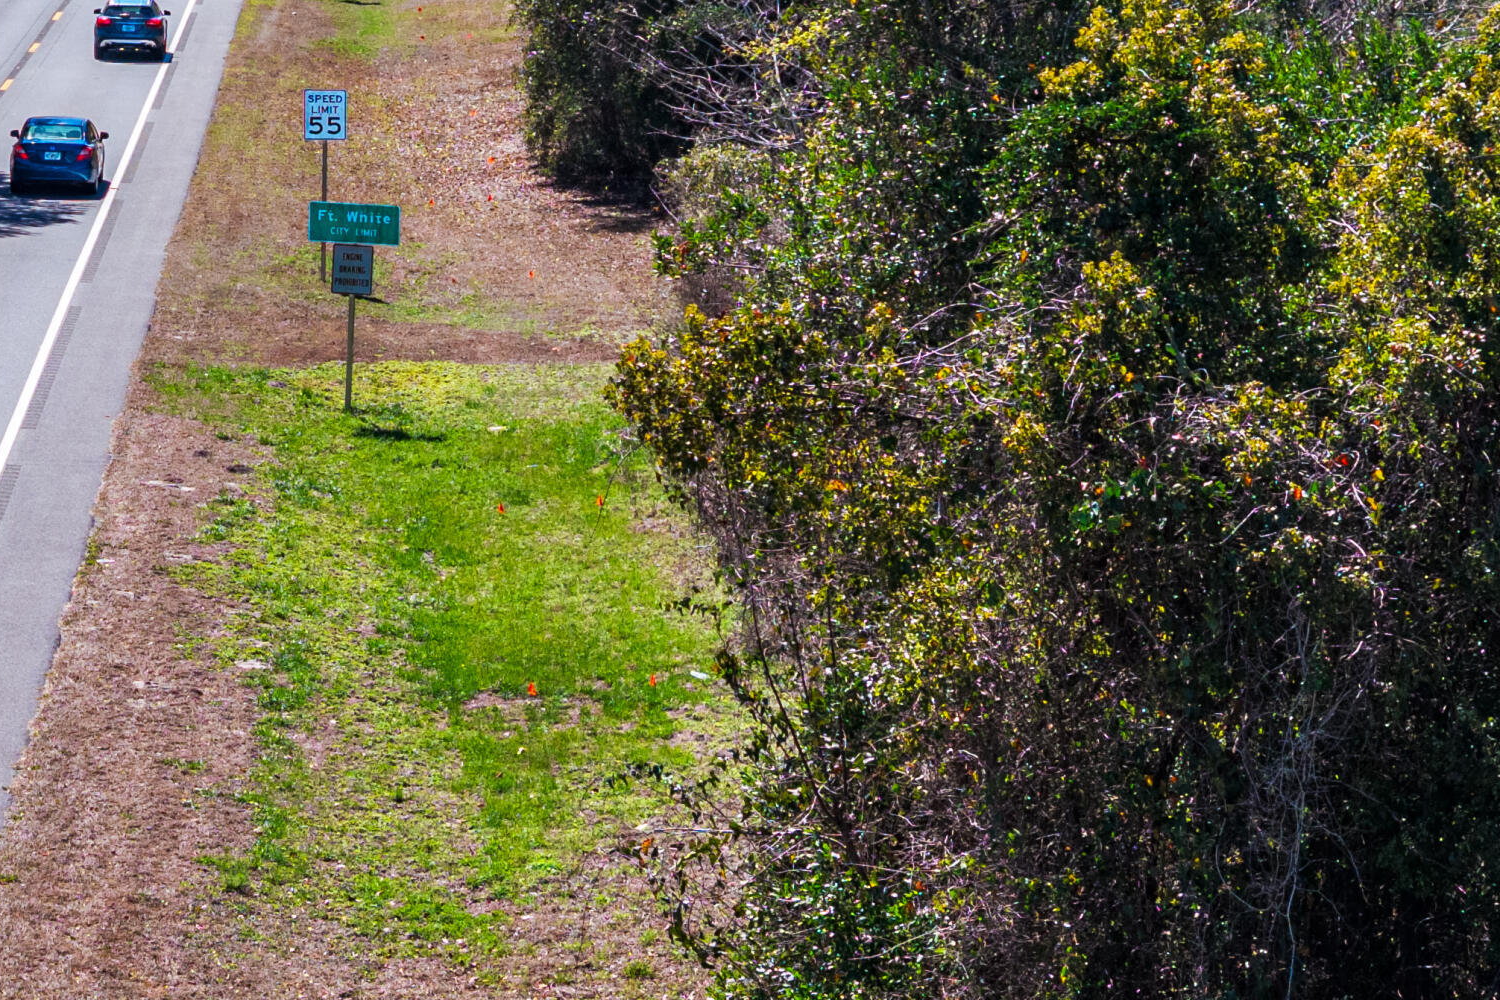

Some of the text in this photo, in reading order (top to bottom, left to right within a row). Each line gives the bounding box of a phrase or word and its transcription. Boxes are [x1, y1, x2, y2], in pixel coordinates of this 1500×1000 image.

[307, 94, 343, 103] SPEED
[311, 105, 340, 114] LIMIT
[308, 117, 341, 135] 55
[317, 209, 391, 225] Ft. White
[330, 226, 349, 236] CITY
